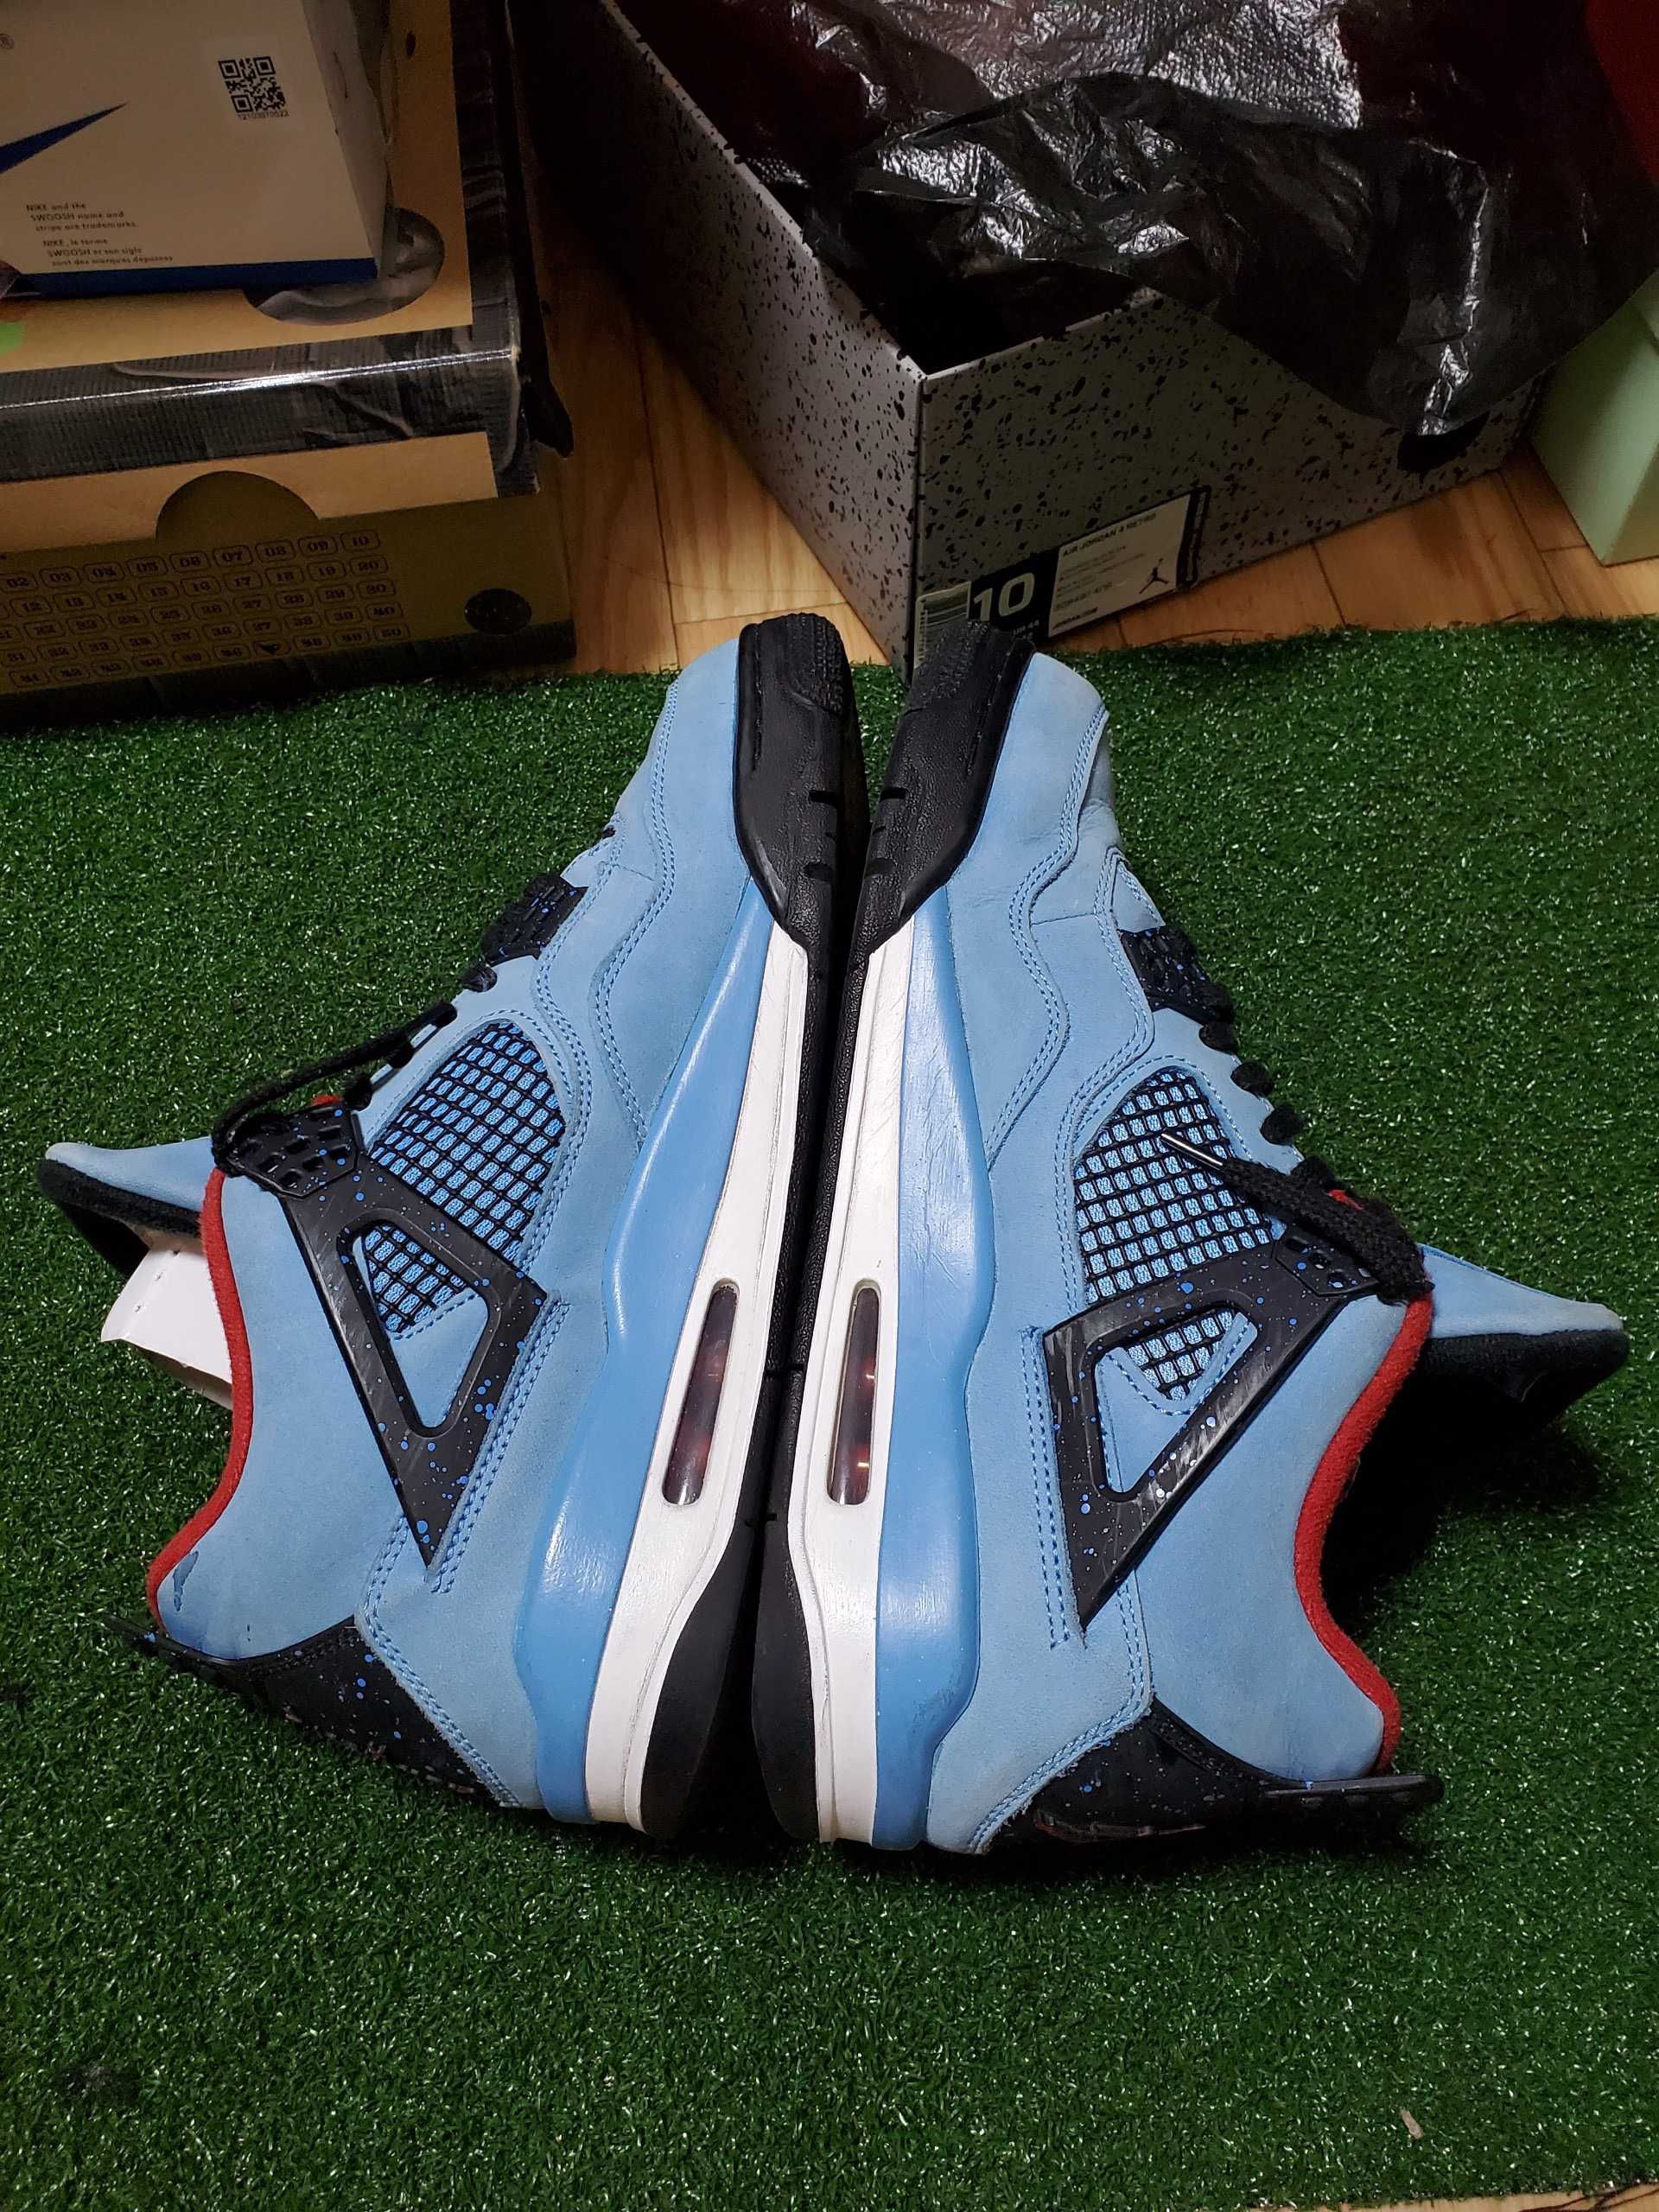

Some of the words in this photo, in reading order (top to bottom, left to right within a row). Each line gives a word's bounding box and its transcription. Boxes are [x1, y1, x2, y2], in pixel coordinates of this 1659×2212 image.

[30, 213, 75, 221] SWOOSH
[48, 249, 91, 257] SWOOSH
[1063, 546, 1078, 557] AIR
[1080, 530, 1116, 550] JORDAN
[1126, 512, 1157, 530] RETRO
[7, 578, 30, 588] 02
[50, 572, 72, 582] 03
[92, 567, 116, 577] 04
[137, 562, 158, 573] 05
[180, 556, 201, 567] 06
[221, 551, 243, 563] 07
[264, 546, 287, 556] 08
[307, 540, 328, 551] 09
[353, 536, 370, 547] 10
[22, 601, 42, 612] 12
[66, 597, 84, 607] 13
[108, 592, 127, 602] 14
[151, 587, 168, 597] 15
[194, 581, 211, 592] 16
[234, 575, 251, 587] 17
[276, 571, 295, 582] 18
[318, 566, 336, 576] 19
[358, 560, 379, 571] 20
[242, 600, 262, 609] 27
[283, 594, 305, 605] 28
[325, 589, 346, 600] 29
[365, 583, 386, 594] 30
[974, 572, 1035, 621] 10
[8, 652, 27, 663] 31
[48, 647, 69, 658] 32
[213, 626, 232, 637] 36
[252, 621, 270, 632] 37
[292, 616, 313, 626] 38
[333, 611, 353, 621] 39
[372, 607, 395, 616] 40
[21, 674, 40, 683] 41
